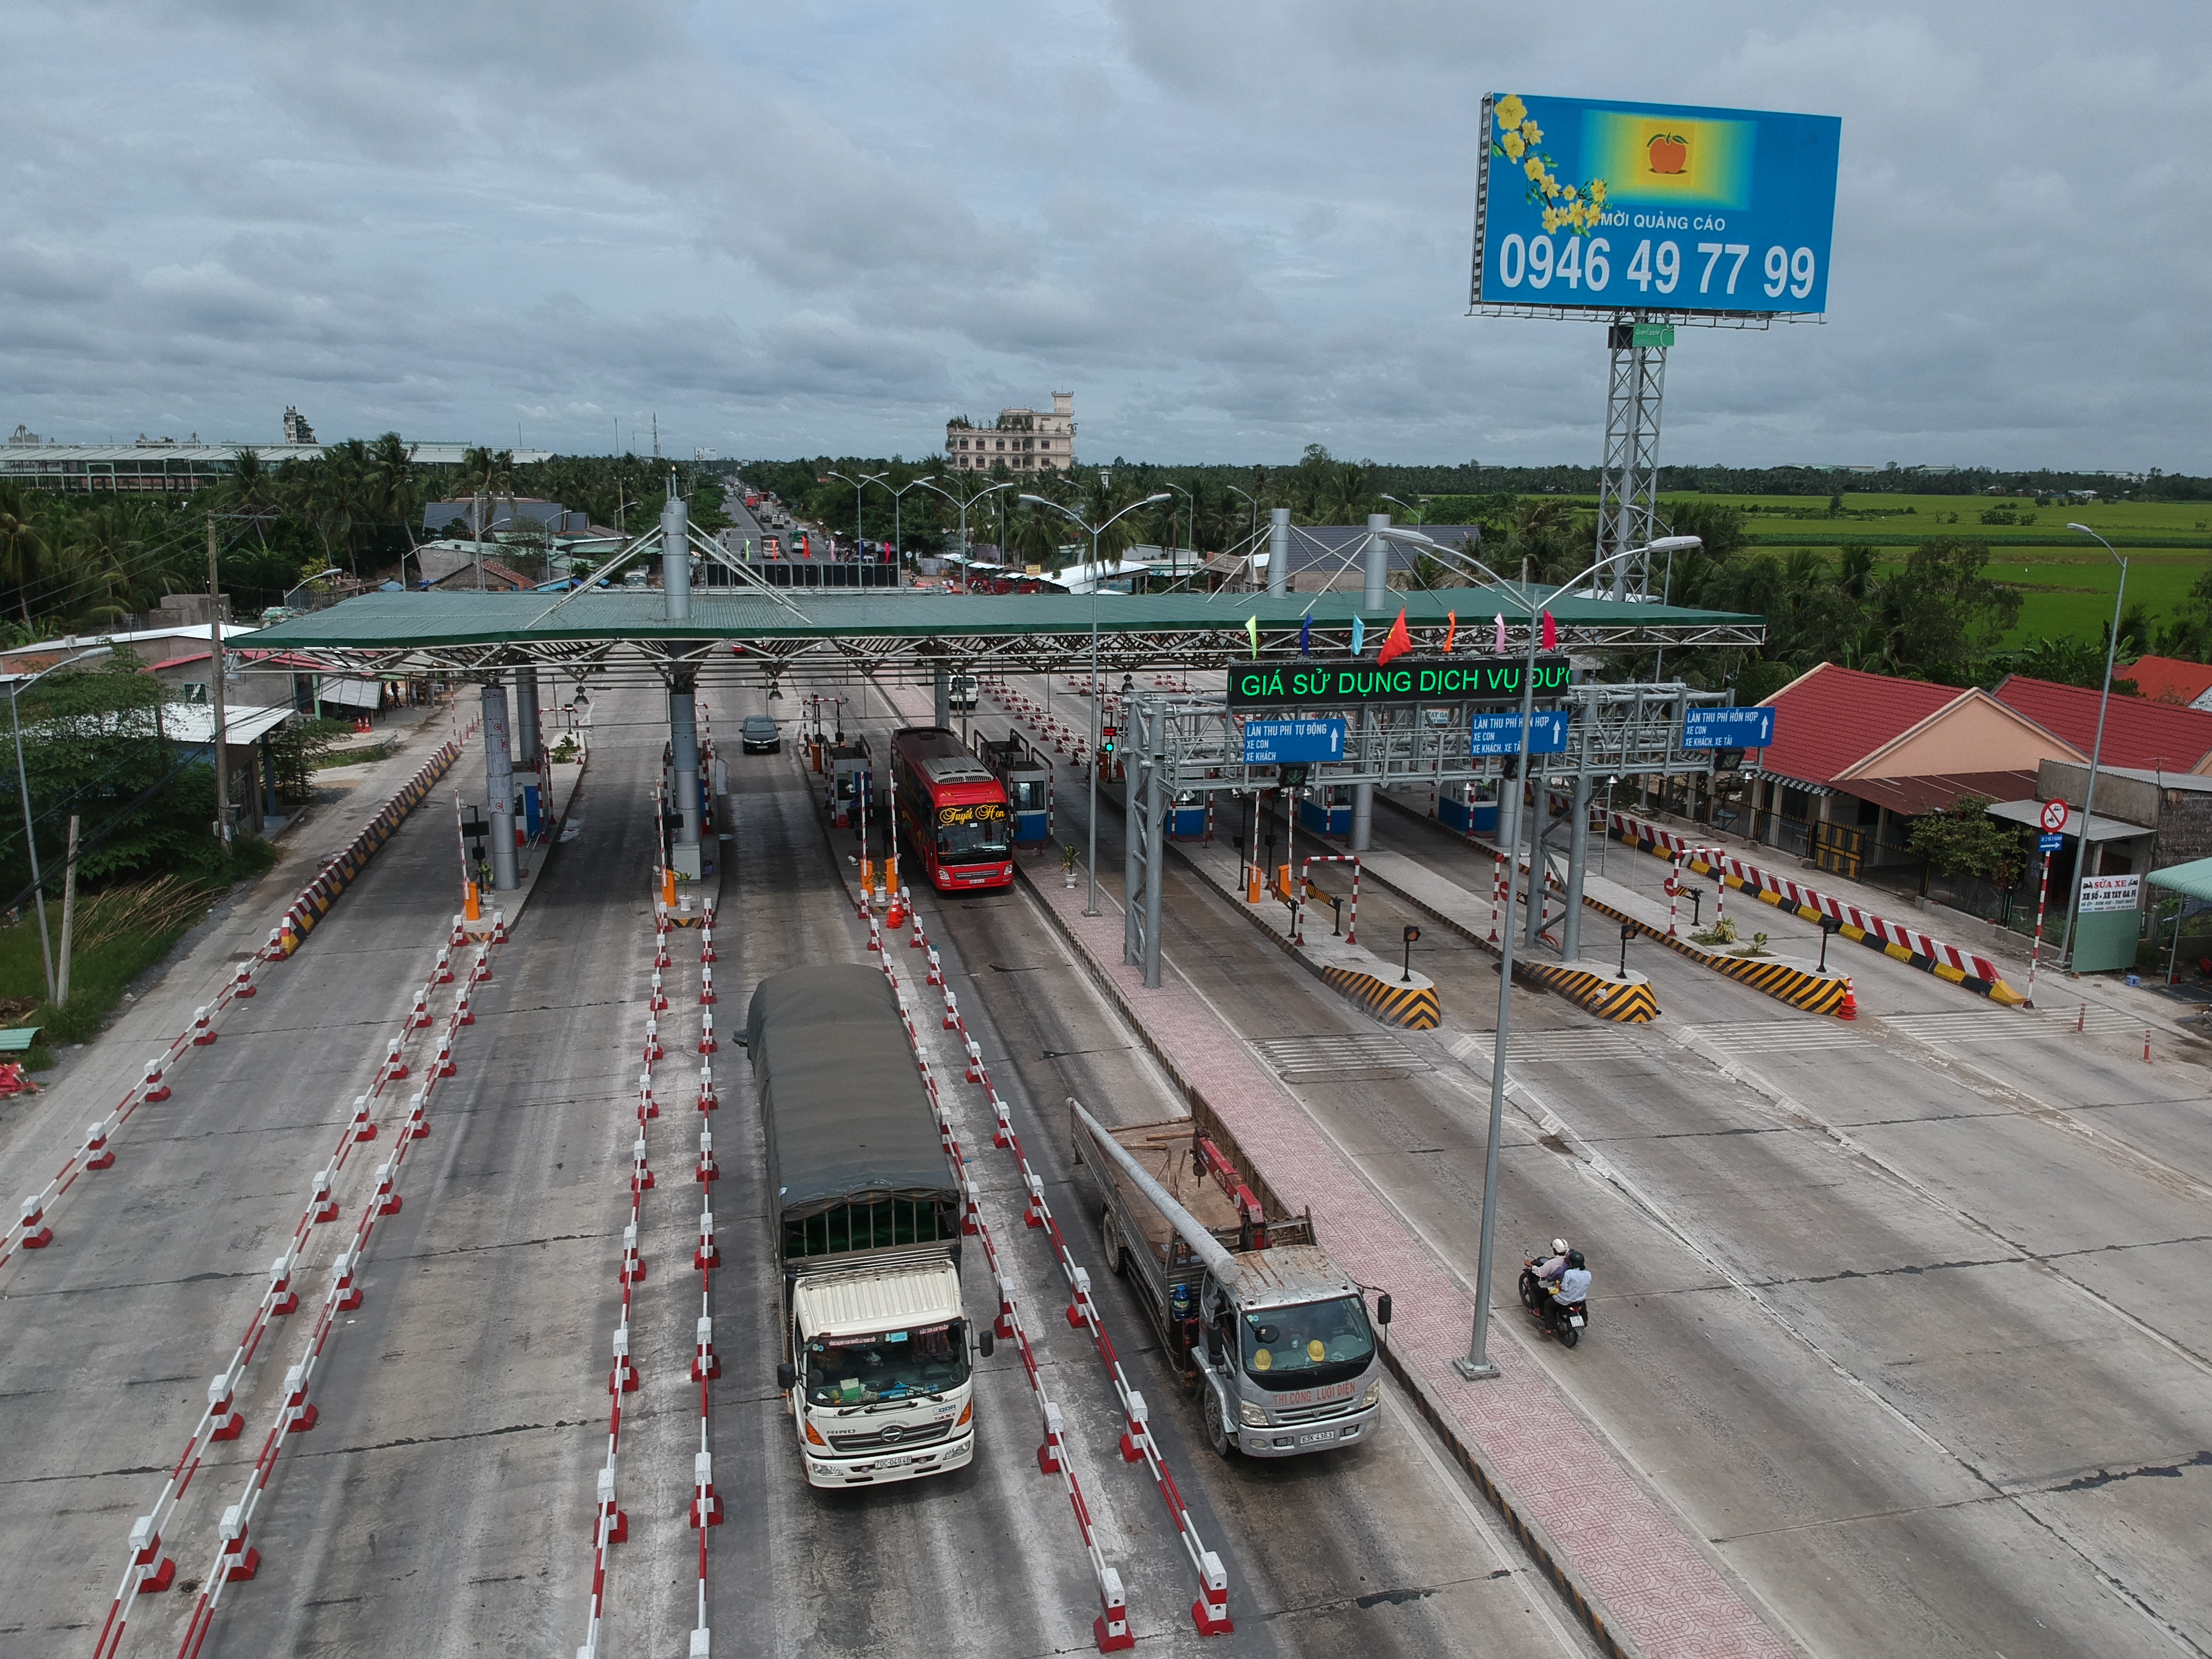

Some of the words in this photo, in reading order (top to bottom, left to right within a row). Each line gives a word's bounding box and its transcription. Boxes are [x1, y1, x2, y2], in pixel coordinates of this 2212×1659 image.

[1600, 210, 1629, 227] MỜI
[1634, 211, 1688, 230] QUẢNG
[1694, 215, 1725, 231] CÁO
[1500, 234, 1610, 292] 0946
[1627, 240, 1680, 294] 49
[1697, 243, 1749, 294] 77
[1764, 245, 1815, 299] 99
[1241, 669, 1284, 696] GIÁ
[1293, 668, 1331, 694] SỬ
[1339, 671, 1411, 697] DỤNG
[1420, 670, 1478, 695] DỊCH
[1487, 668, 1519, 692] VỤ
[1474, 716, 1488, 729] LÀN
[1490, 718, 1503, 729] THU
[1505, 715, 1519, 728] PHÍ
[1519, 717, 1533, 728] HN
[1535, 716, 1549, 729] HỢP
[1687, 711, 1700, 723] LÀN
[1702, 712, 1715, 722] THU
[1716, 710, 1729, 722] PHÍ
[1729, 709, 1743, 722] HỖN
[1744, 711, 1758, 724] HỢP
[1246, 724, 1261, 737] LÀN
[1263, 725, 1278, 736] THU
[1279, 722, 1293, 736] PHÍ
[1295, 724, 1305, 737] TỰ
[1307, 722, 1327, 736] ĐỘNG
[1695, 726, 1706, 734] CON
[1473, 733, 1481, 741] XE
[1482, 732, 1495, 741] CON
[1685, 738, 1693, 746] XE
[1715, 738, 1722, 746] XE
[1724, 735, 1732, 745] TẢI
[1246, 740, 1254, 749] XE
[1256, 740, 1269, 749] CON
[1472, 744, 1479, 754] XE
[1504, 744, 1512, 752] XE
[1246, 753, 1254, 761] XE
[1255, 750, 1276, 761] KHÁCH
[2094, 879, 2112, 889] SỬA
[1273, 1394, 1287, 1405] THI
[1290, 1390, 1311, 1404] CÔNG
